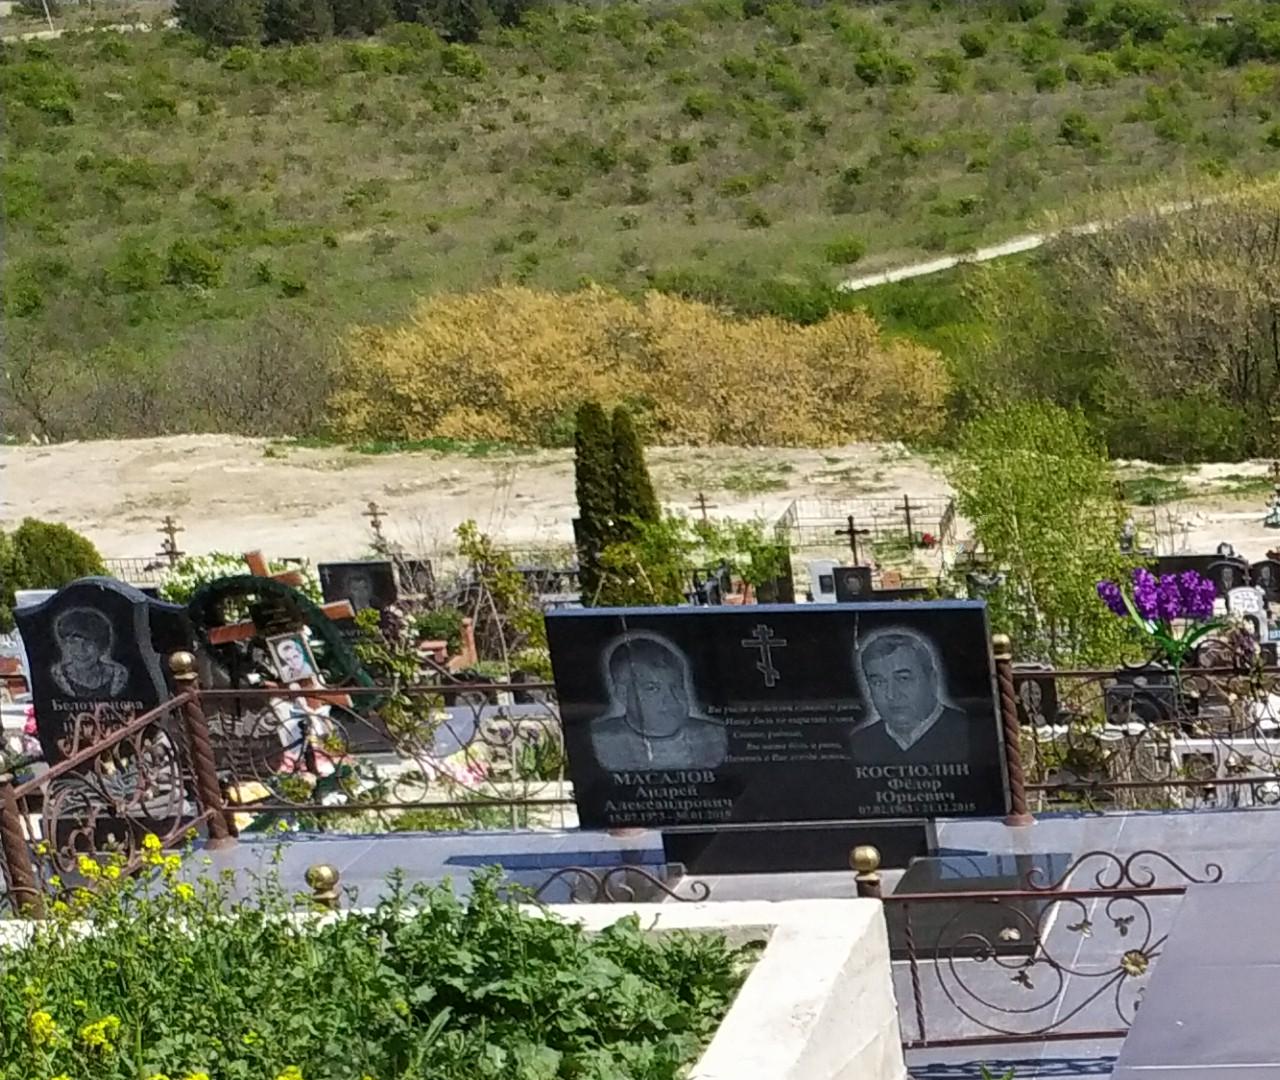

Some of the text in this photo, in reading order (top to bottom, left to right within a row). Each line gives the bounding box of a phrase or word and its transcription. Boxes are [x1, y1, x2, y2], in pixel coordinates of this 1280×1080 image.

[613, 770, 716, 785] МАСАЛОВ
[856, 763, 970, 779] КОСТЮЛИН
[636, 785, 698, 799] Андрей
[875, 791, 956, 804] Юрьевич
[604, 799, 733, 812] Александрович
